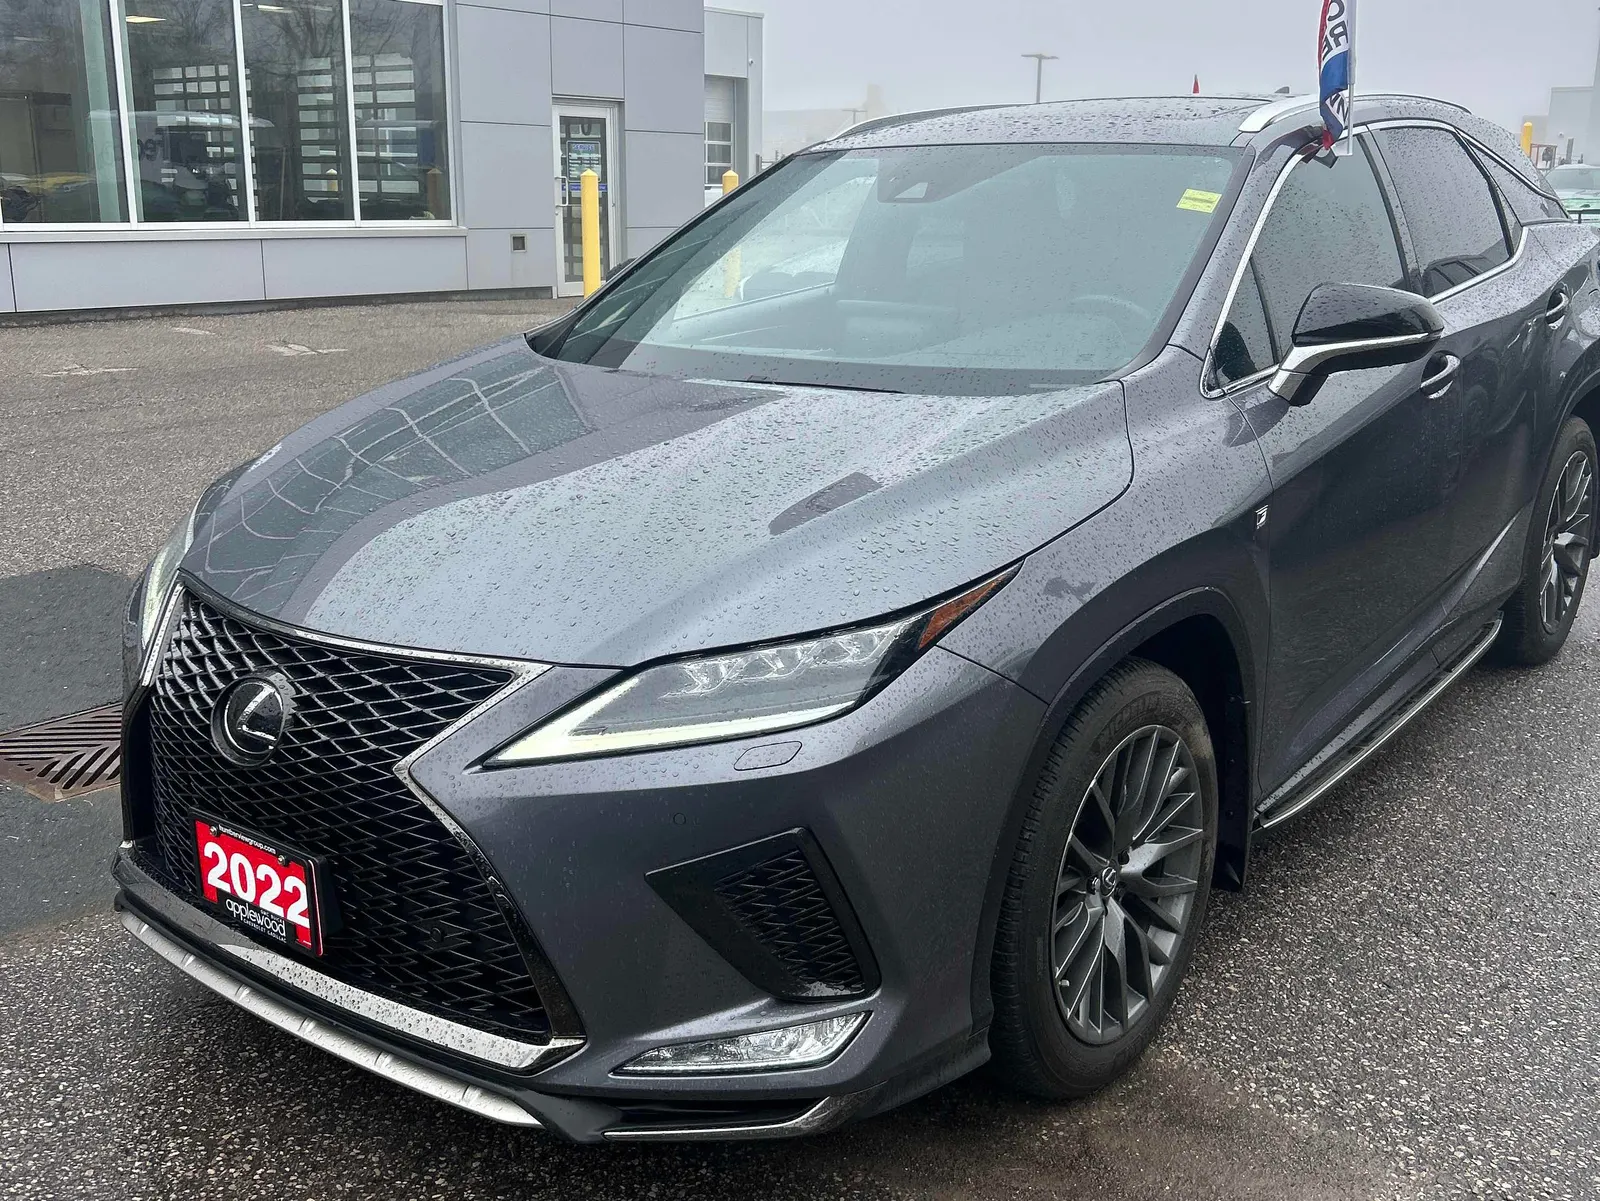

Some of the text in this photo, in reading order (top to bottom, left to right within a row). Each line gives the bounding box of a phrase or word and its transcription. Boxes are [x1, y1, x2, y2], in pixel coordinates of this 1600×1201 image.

[203, 841, 311, 929] 2022
[225, 898, 286, 937] applewood
[243, 918, 287, 944] CHEVROLET CADILLAC
